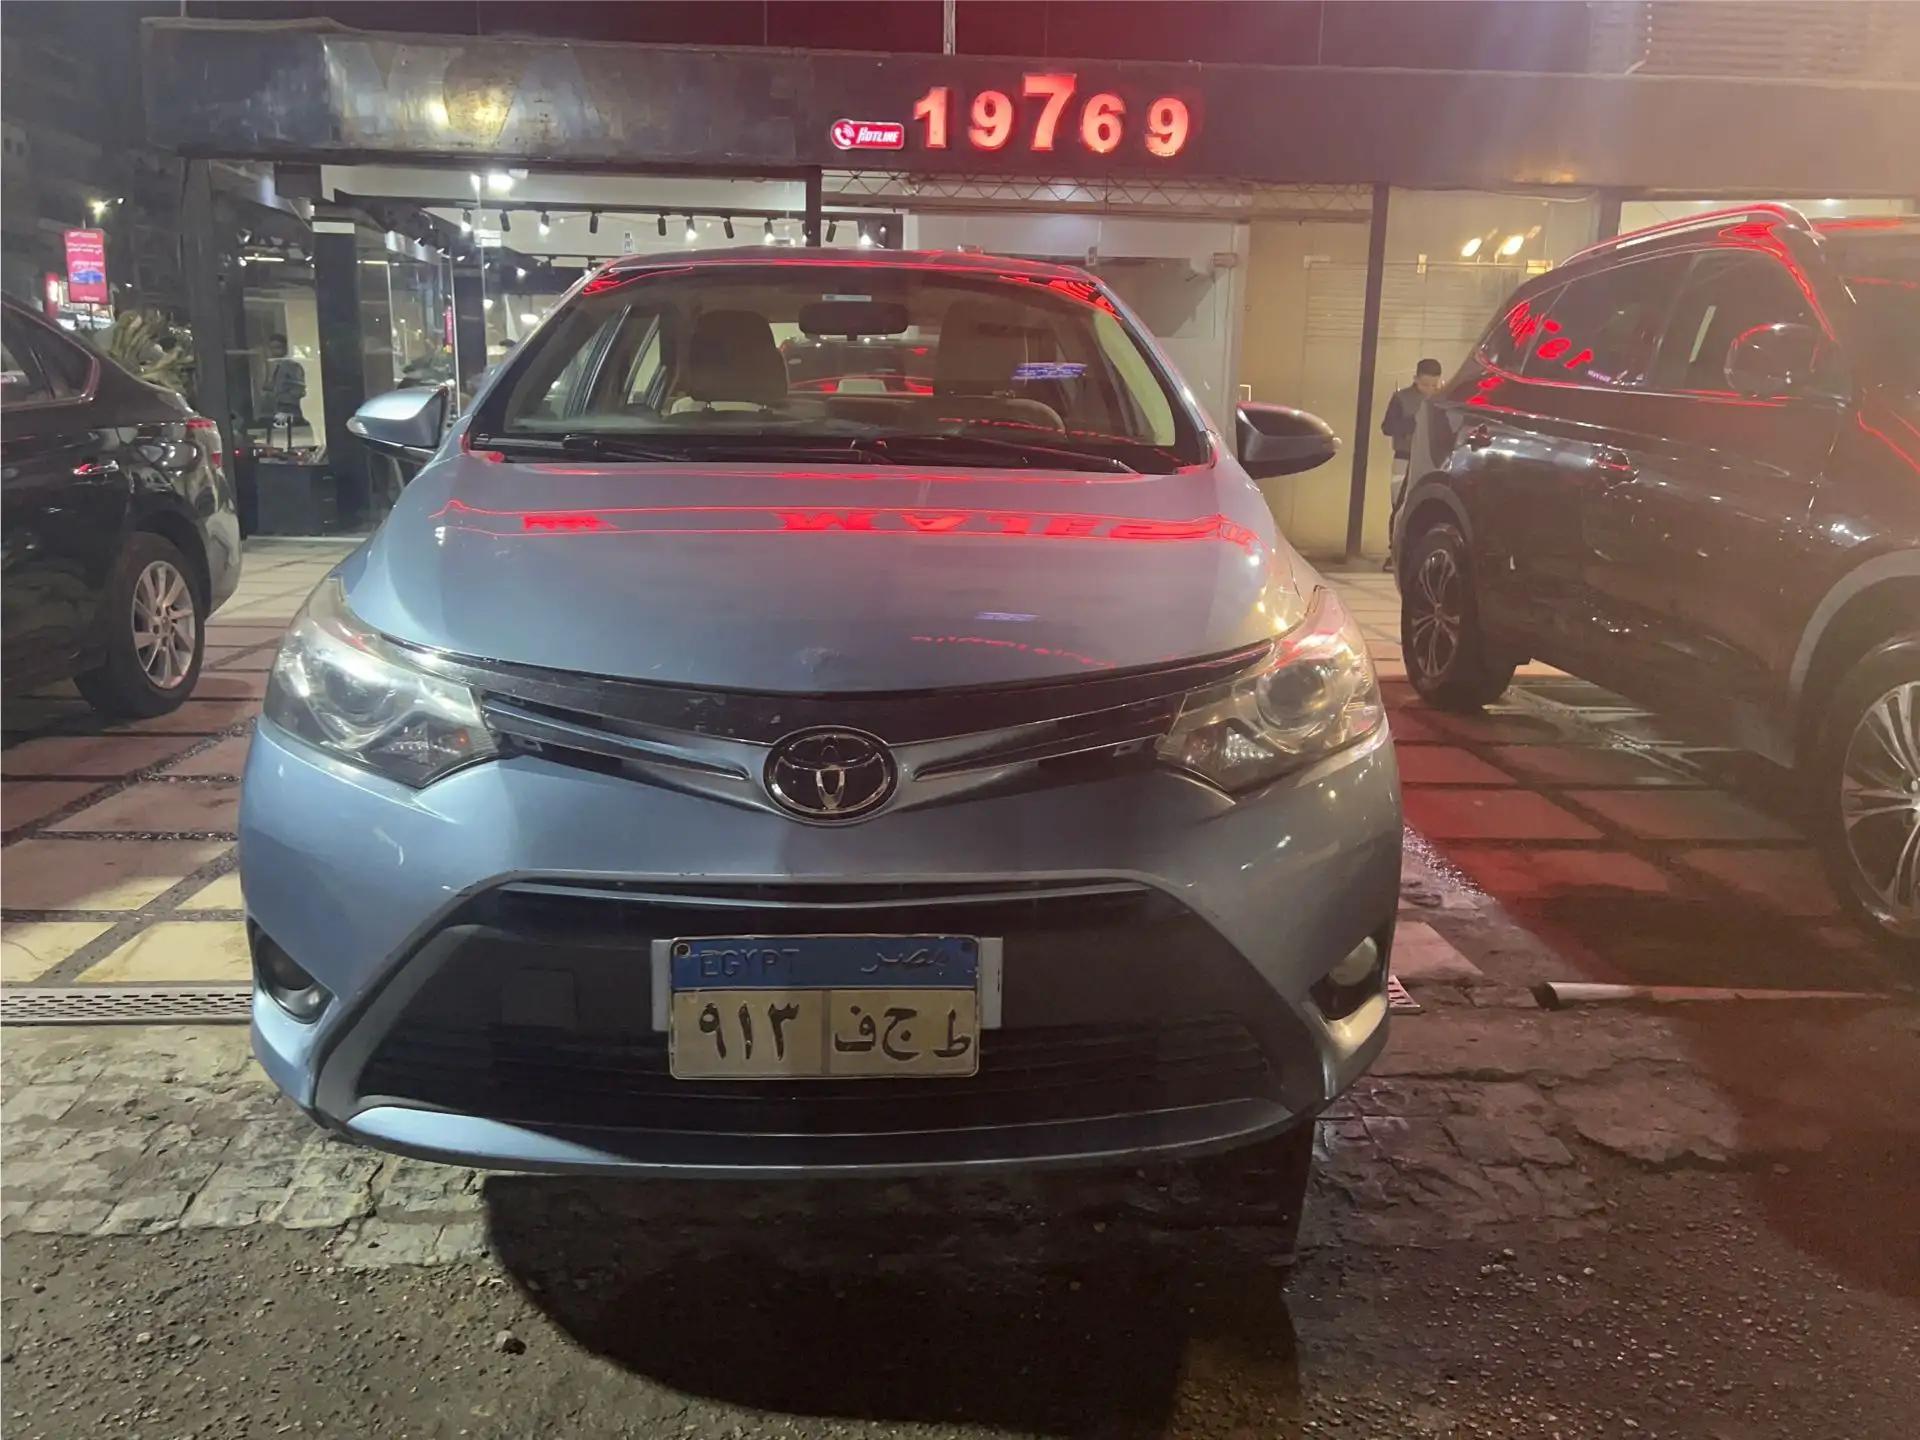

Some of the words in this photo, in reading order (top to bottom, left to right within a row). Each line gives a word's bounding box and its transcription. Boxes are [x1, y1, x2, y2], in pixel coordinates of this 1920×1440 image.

[913, 73, 1190, 157] 19769
[701, 949, 800, 976] EGYPT
[699, 1003, 800, 1061] ٩١٣
